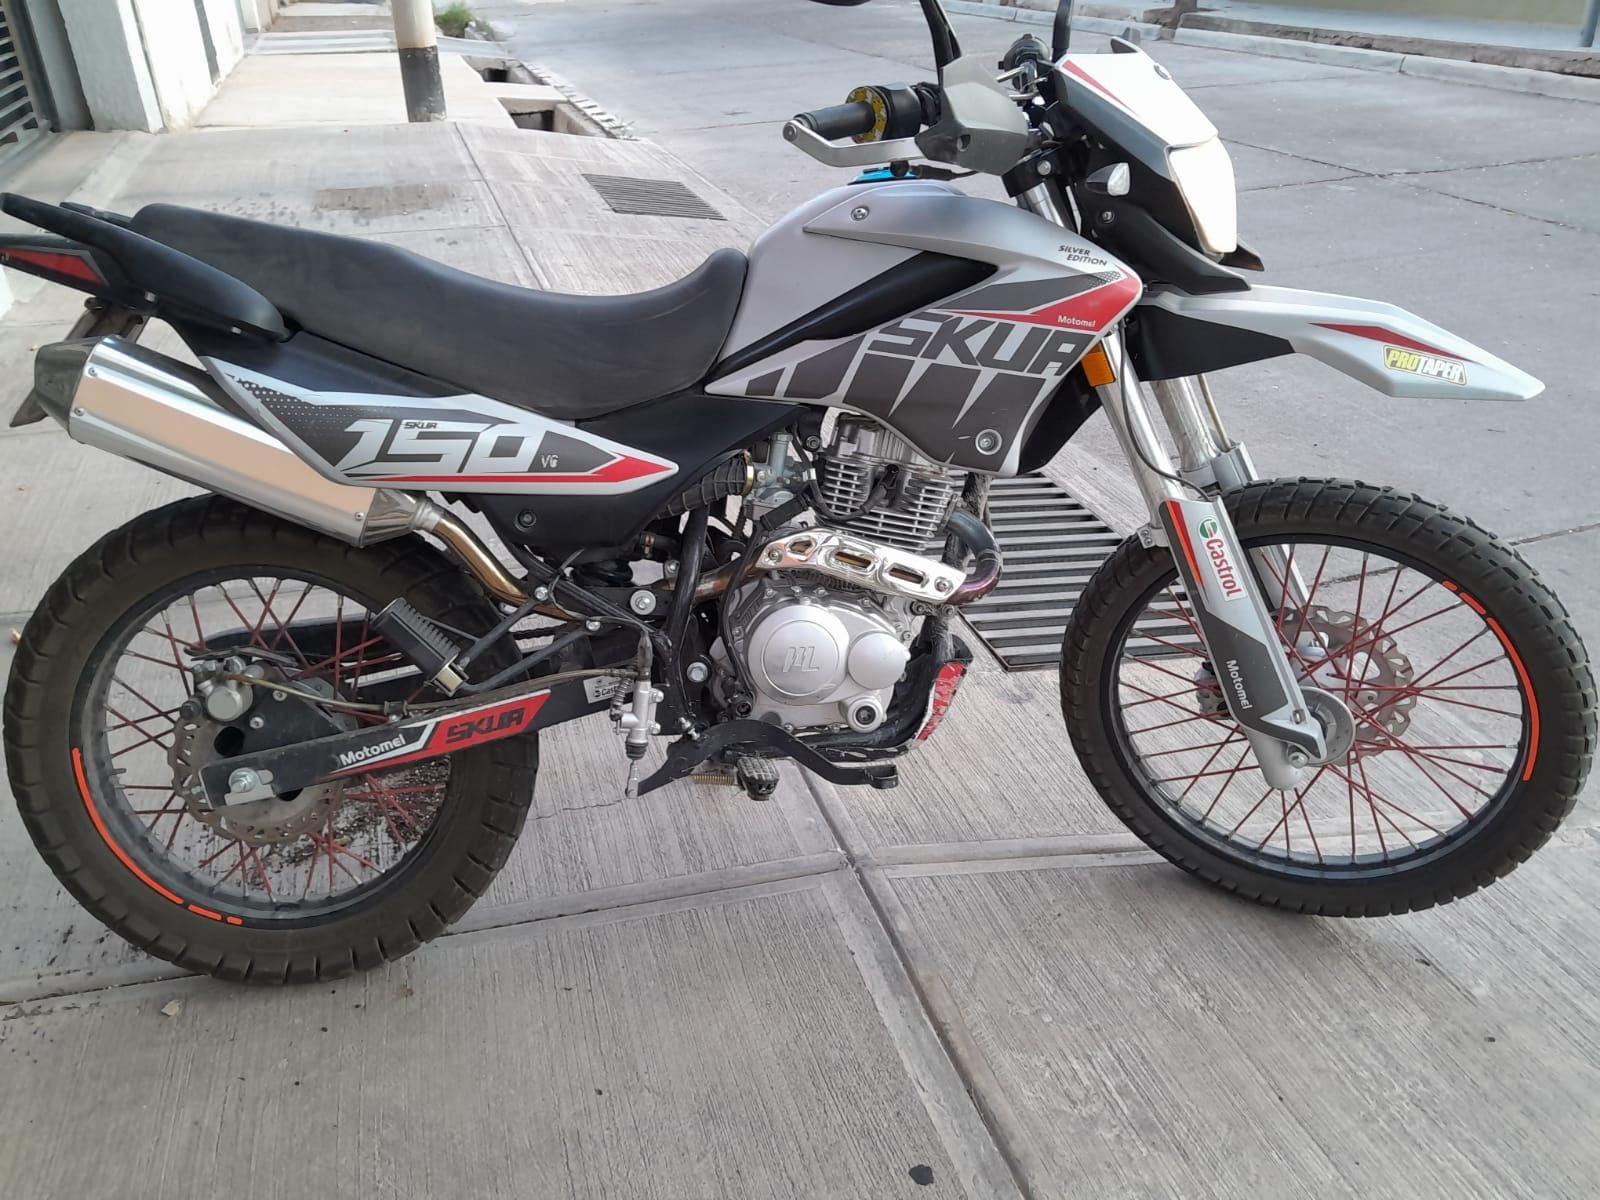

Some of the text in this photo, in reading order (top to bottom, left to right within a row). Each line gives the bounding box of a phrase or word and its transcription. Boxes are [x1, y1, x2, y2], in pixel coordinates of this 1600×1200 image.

[1058, 245, 1091, 256] SILVER
[1066, 254, 1108, 266] EDITION
[1057, 315, 1097, 328] Motomel
[867, 311, 1096, 377] SKUA
[336, 418, 559, 473] 150 V6
[1206, 538, 1243, 597] Castrol
[1226, 659, 1253, 710] Motomel
[340, 734, 406, 767] Motomel
